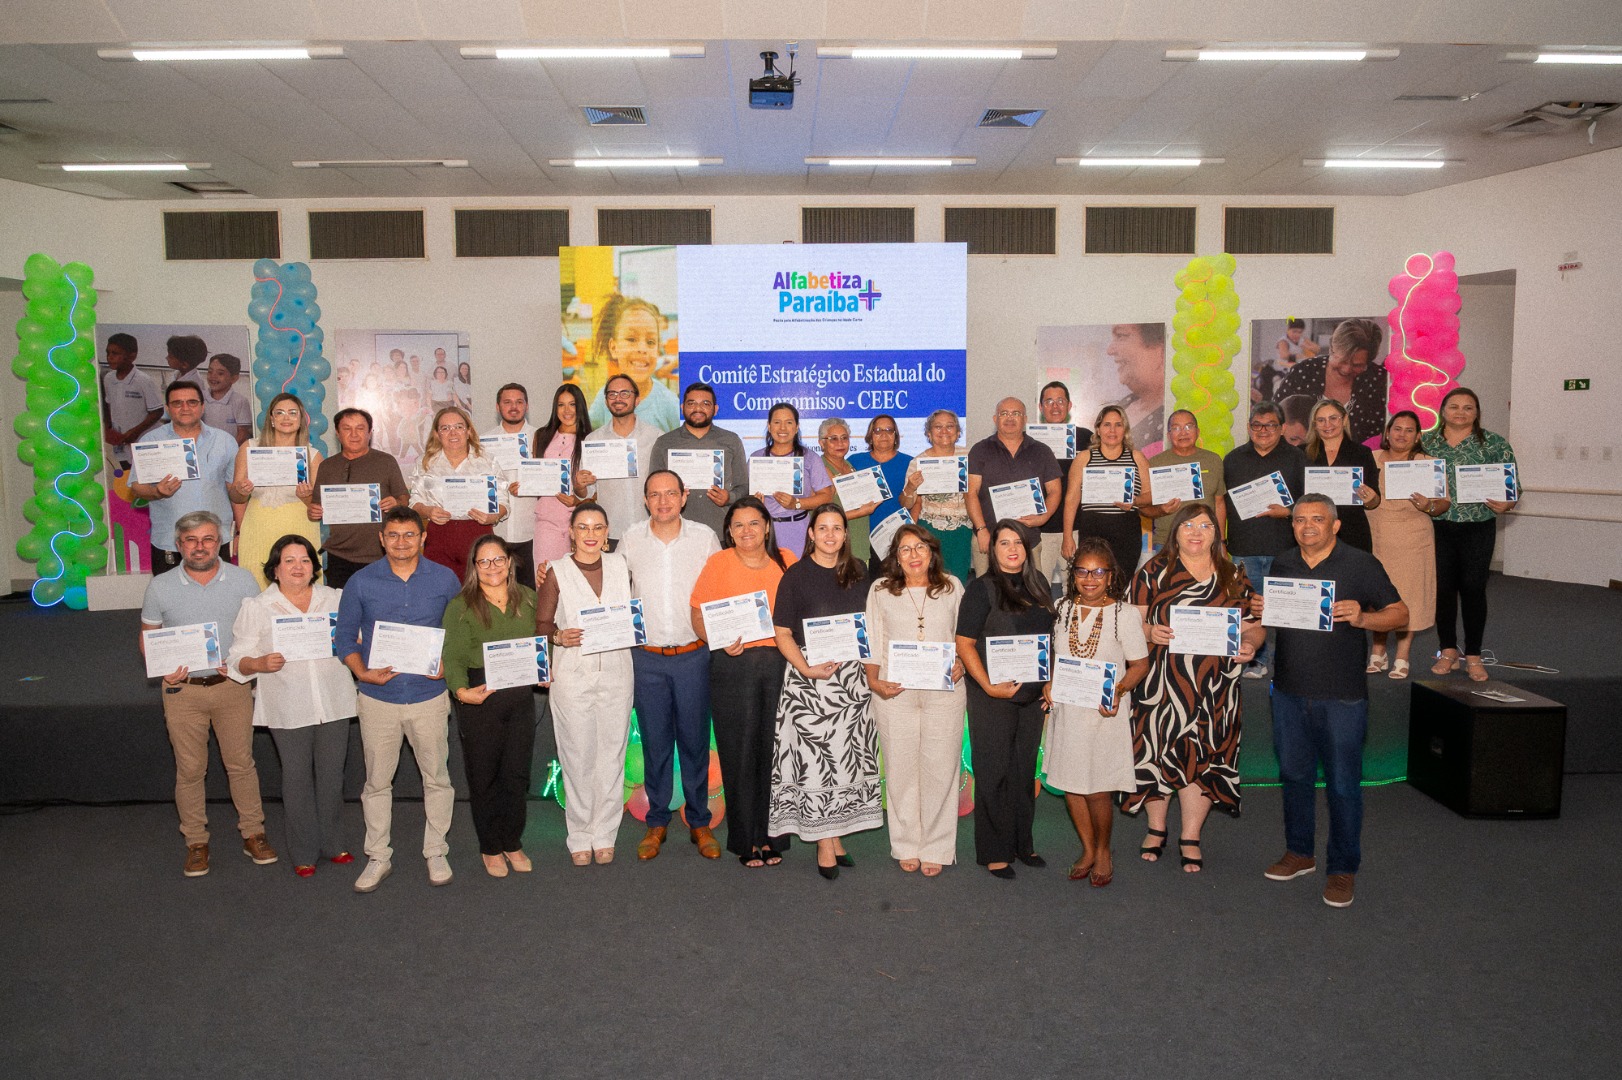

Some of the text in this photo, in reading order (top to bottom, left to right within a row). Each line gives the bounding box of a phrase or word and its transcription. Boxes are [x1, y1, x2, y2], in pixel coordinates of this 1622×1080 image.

[773, 271, 862, 290] Alfabetiza
[779, 290, 859, 313] Paraíba
[698, 362, 946, 388] Comitê Estratégico Estadual do
[857, 390, 908, 410] CEEC
[1268, 588, 1296, 597] Certificado
[1058, 666, 1082, 674] Certificado
